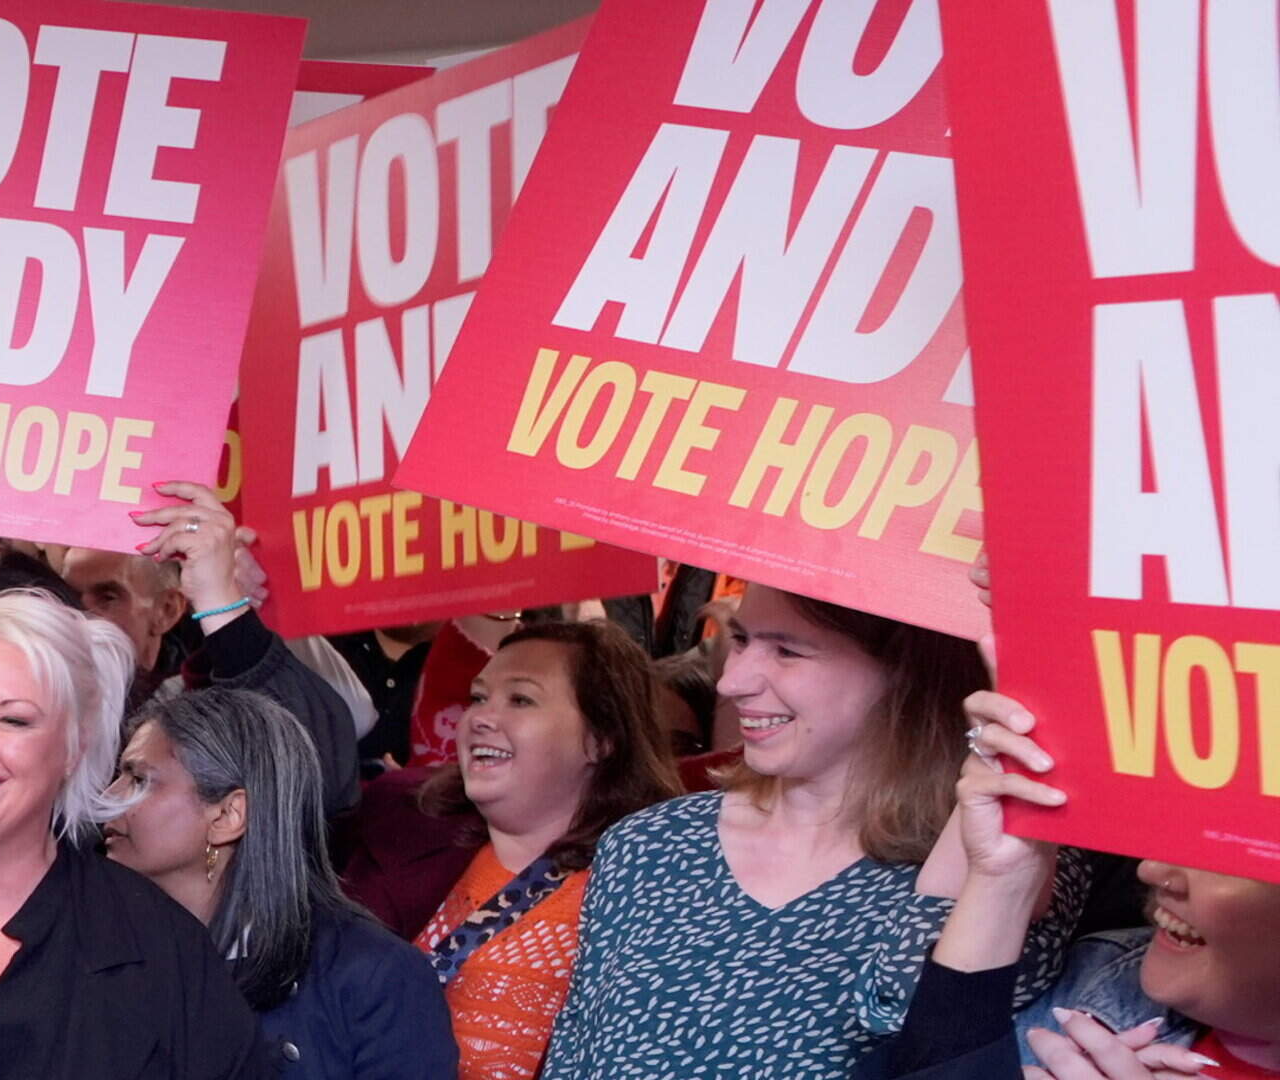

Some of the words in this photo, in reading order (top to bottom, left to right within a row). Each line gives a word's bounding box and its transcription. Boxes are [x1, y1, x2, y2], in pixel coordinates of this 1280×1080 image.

[672, 0, 943, 130] VO
[552, 122, 973, 406] AND
[292, 291, 476, 498] AN
[505, 347, 746, 497] VOTE
[293, 491, 425, 592] VOTE
[441, 499, 596, 570] HO
[1092, 629, 1280, 796] VOT
